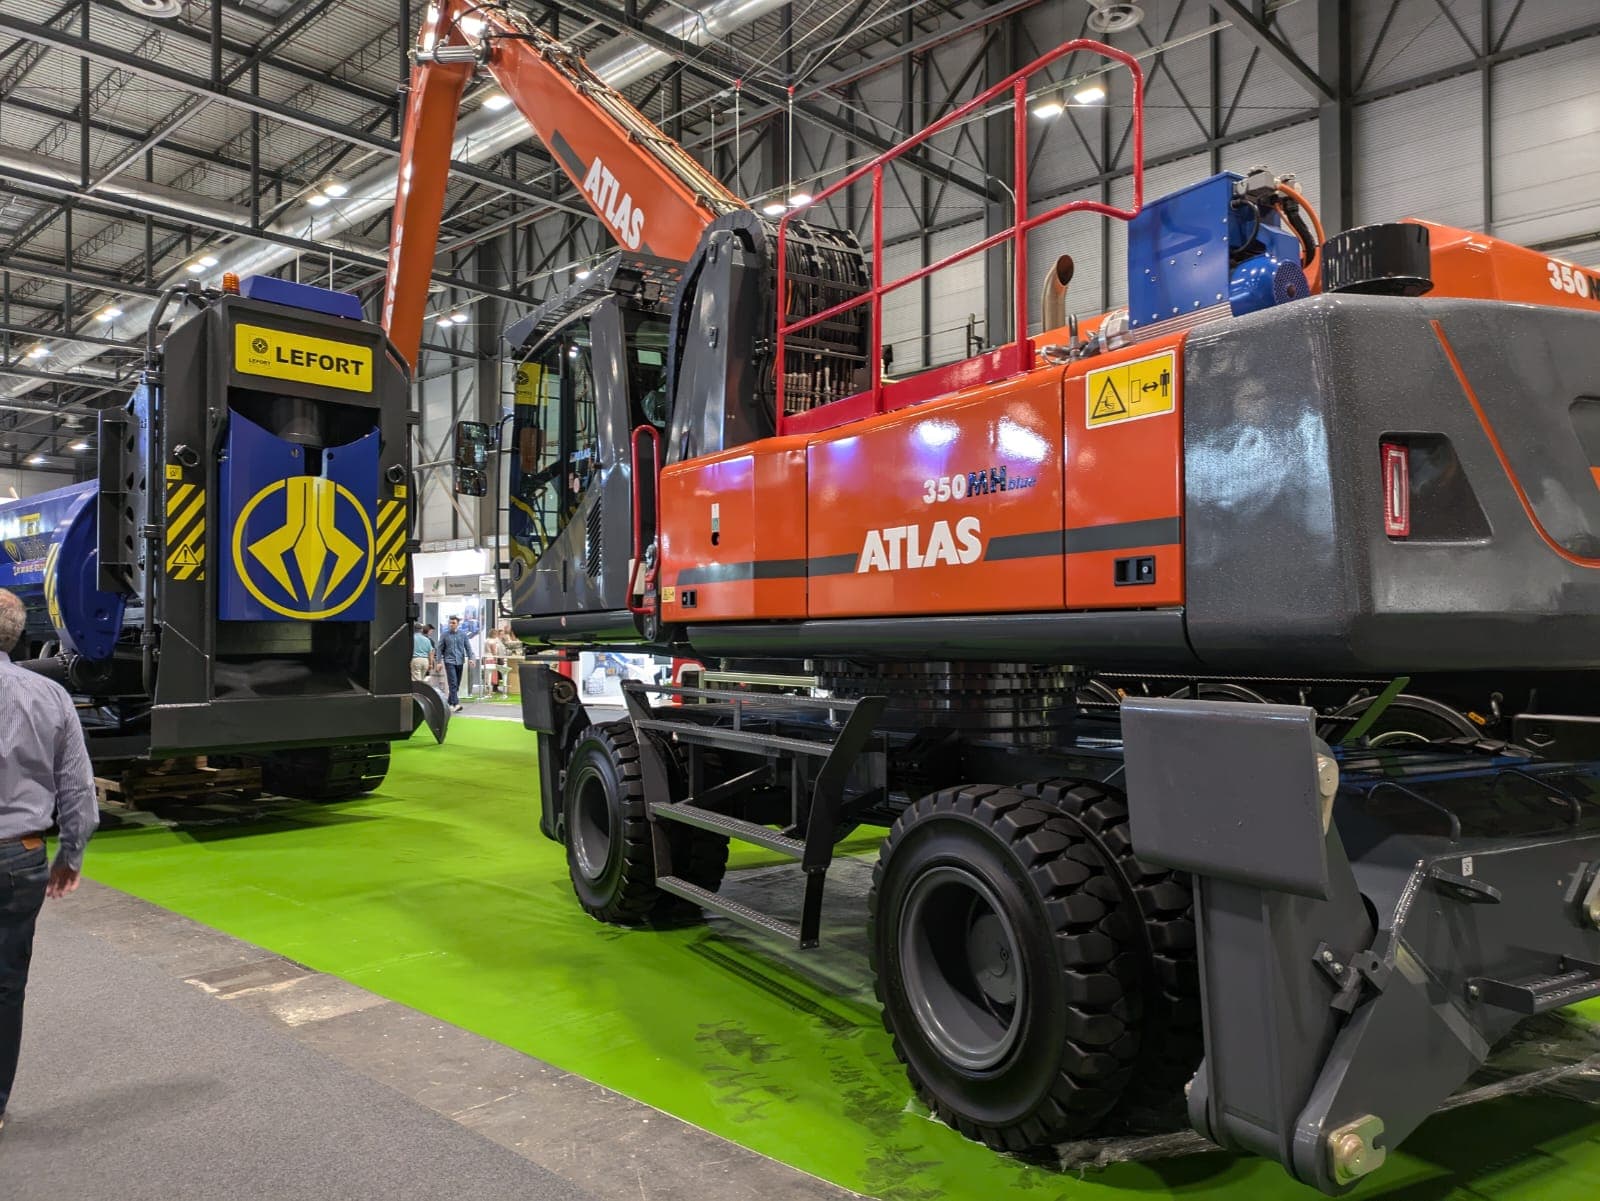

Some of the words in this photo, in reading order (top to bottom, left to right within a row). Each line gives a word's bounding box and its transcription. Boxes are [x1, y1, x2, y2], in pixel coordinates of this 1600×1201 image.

[583, 156, 644, 249] ATLAS
[276, 346, 364, 375] LEFORT
[858, 516, 982, 574] ATLAS
